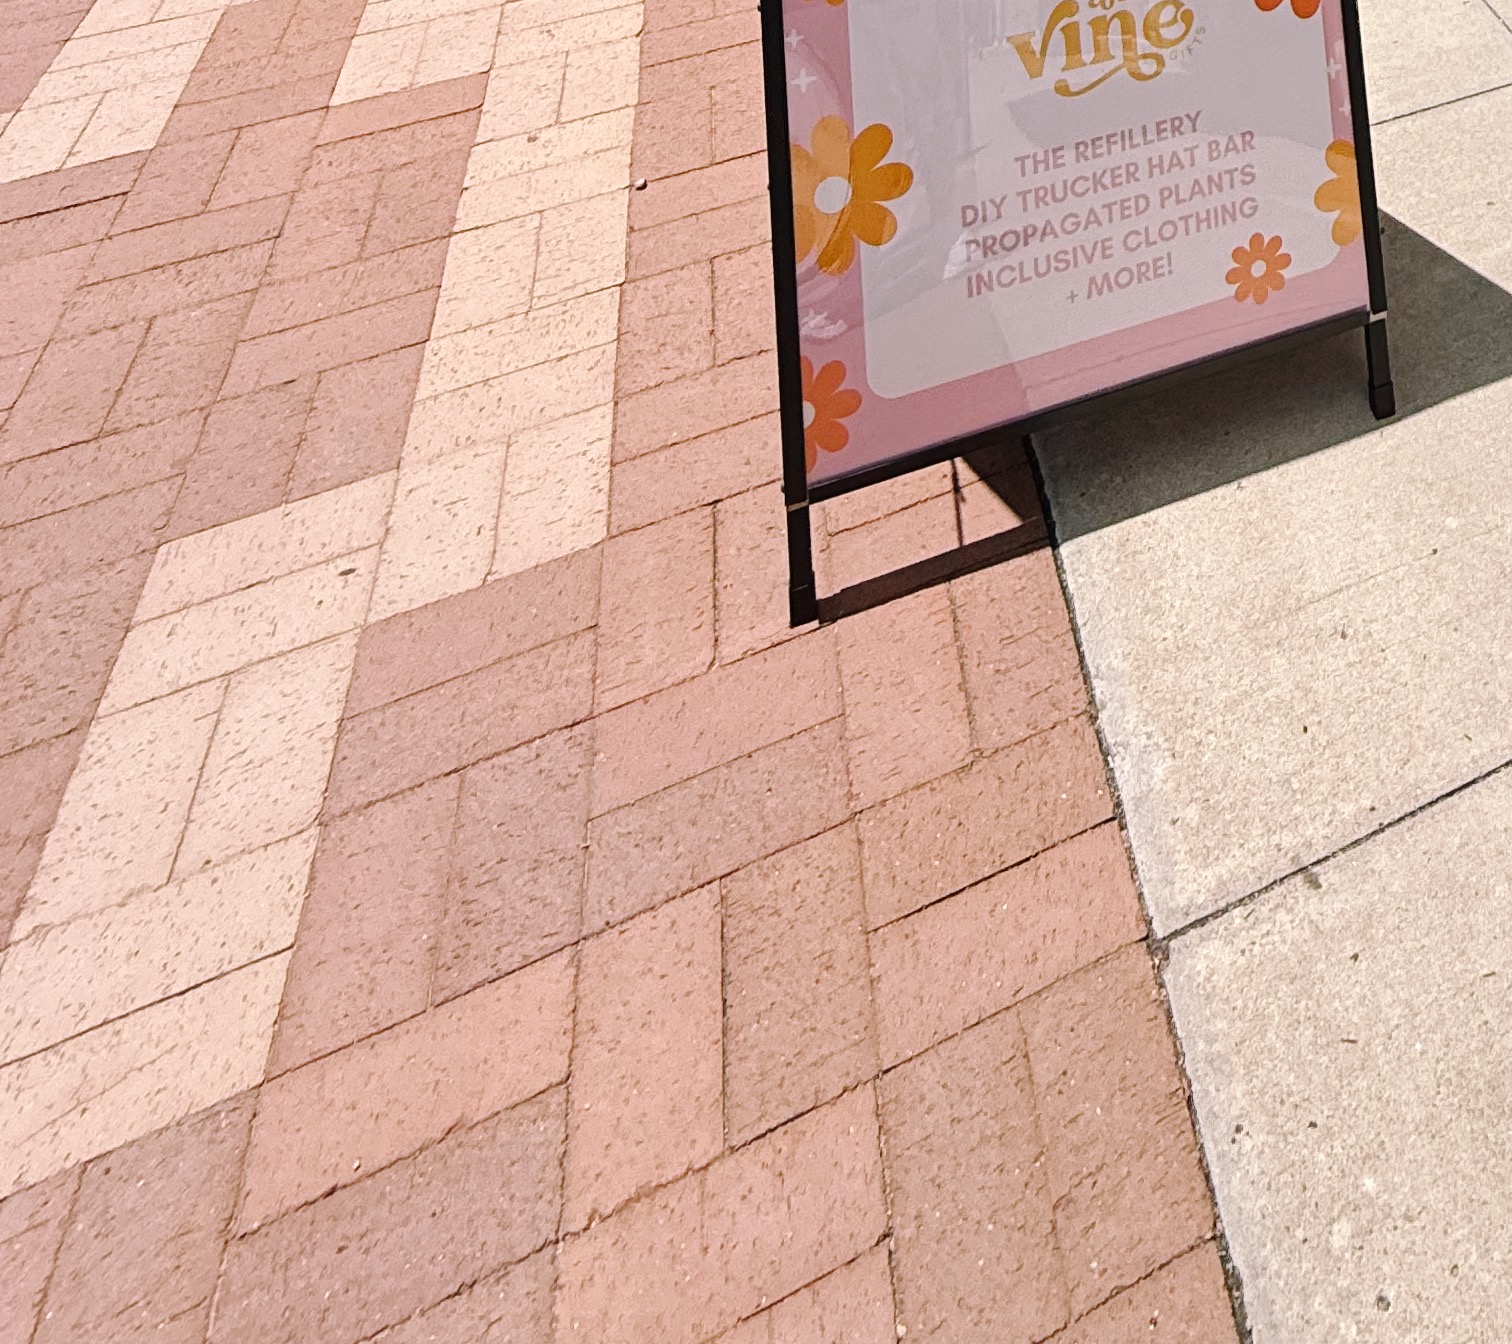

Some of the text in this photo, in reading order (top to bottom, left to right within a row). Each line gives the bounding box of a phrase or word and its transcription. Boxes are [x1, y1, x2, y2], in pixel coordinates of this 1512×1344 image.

[1169, 26, 1206, 61] GIFTS
[961, 130, 1256, 228] DIY TRUCKER HAT BAR
[1014, 110, 1202, 178] THE REFILLERY
[965, 164, 1257, 262] PROPAGATED PLANTS
[966, 197, 1259, 298] INCLUSIVE CLOTHING
[1086, 251, 1173, 300] MORE!
